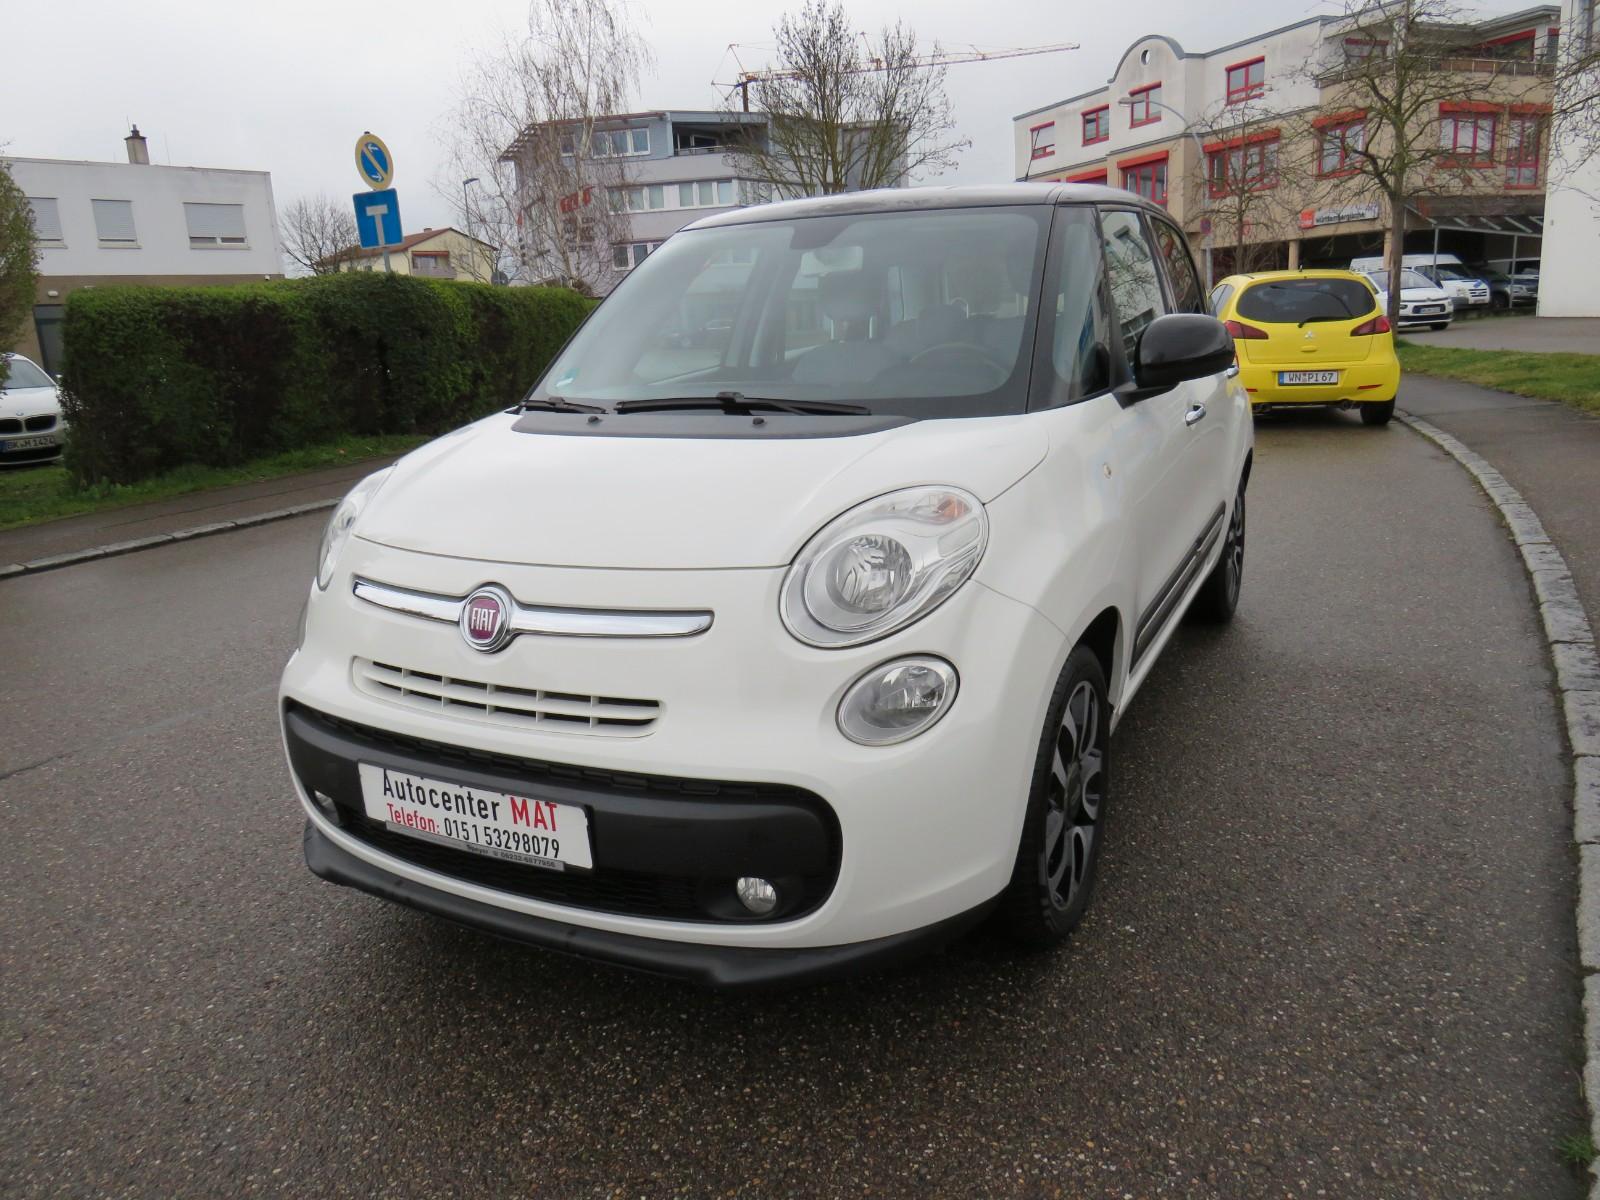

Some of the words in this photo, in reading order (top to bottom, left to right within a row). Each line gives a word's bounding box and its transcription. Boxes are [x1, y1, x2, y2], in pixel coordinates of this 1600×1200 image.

[1289, 372, 1302, 382] WN
[1321, 372, 1334, 382] 67
[471, 607, 496, 632] FIAT
[383, 768, 500, 821] Autocenter
[510, 796, 558, 832] MAT
[386, 802, 440, 834] Telefon:
[444, 817, 480, 844] 0151
[483, 826, 560, 859] 53298079
